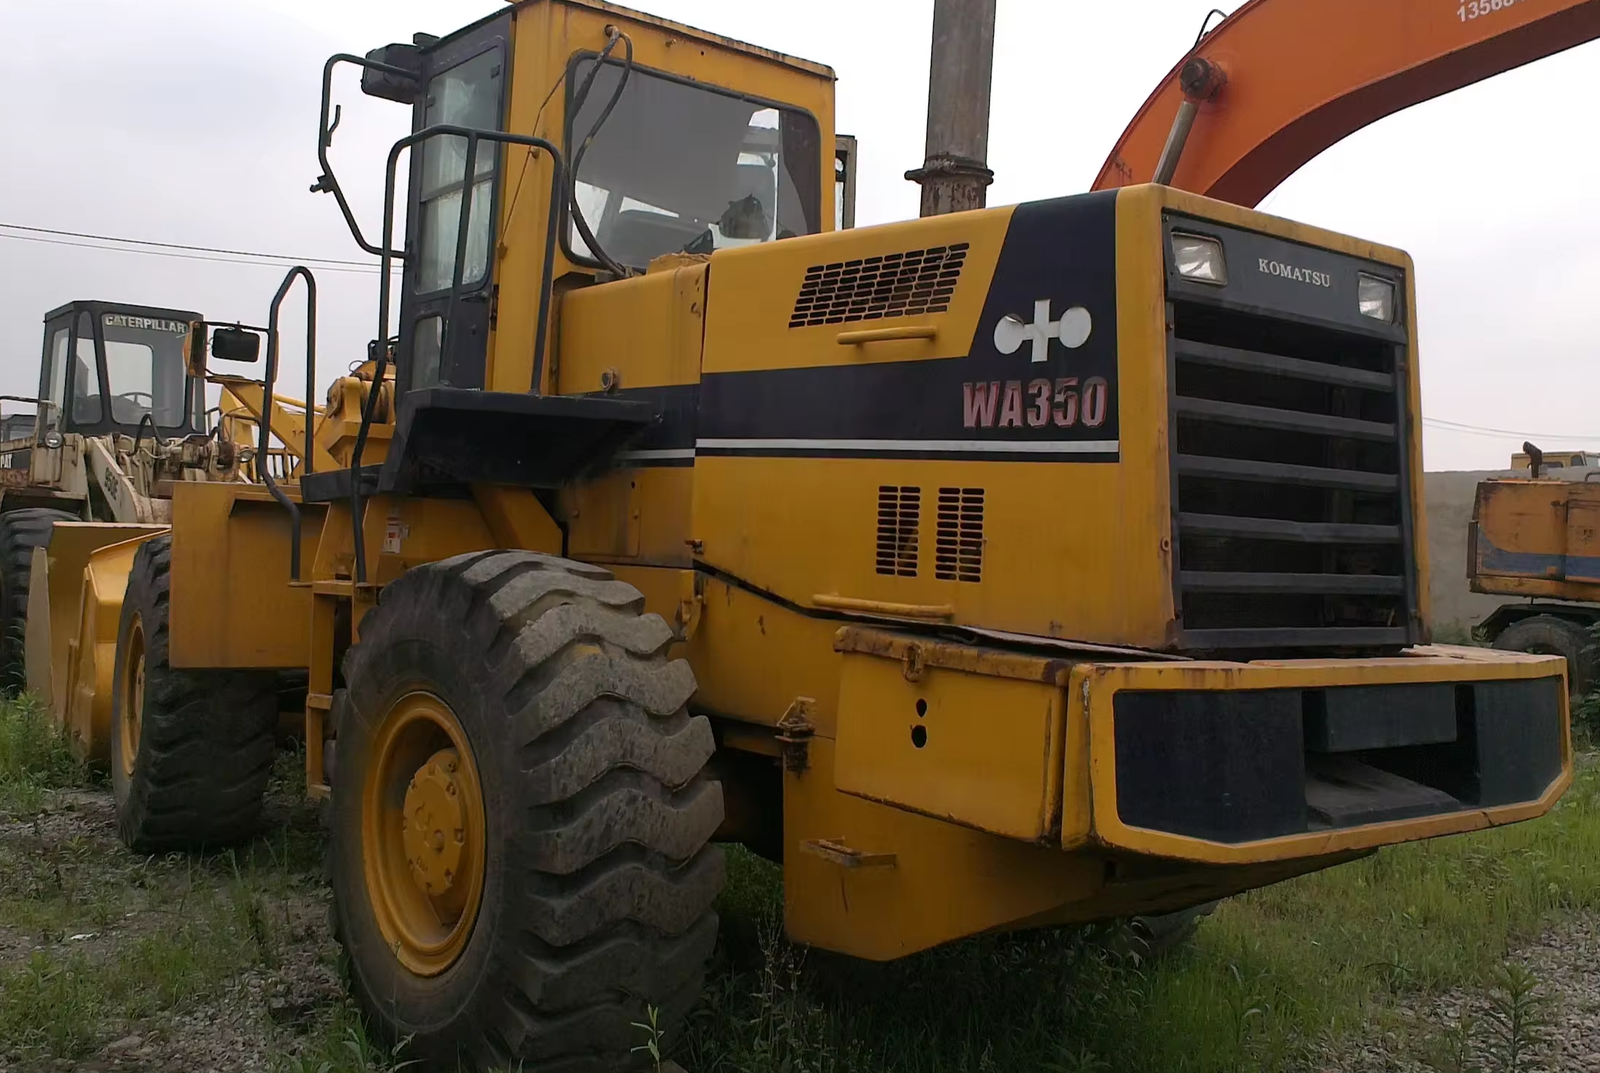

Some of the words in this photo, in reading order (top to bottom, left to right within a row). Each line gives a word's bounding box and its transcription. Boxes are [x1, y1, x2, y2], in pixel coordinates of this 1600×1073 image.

[1258, 258, 1330, 287] KOMATSU
[105, 315, 185, 333] CATERPILLAR
[962, 376, 1109, 429] WA350
